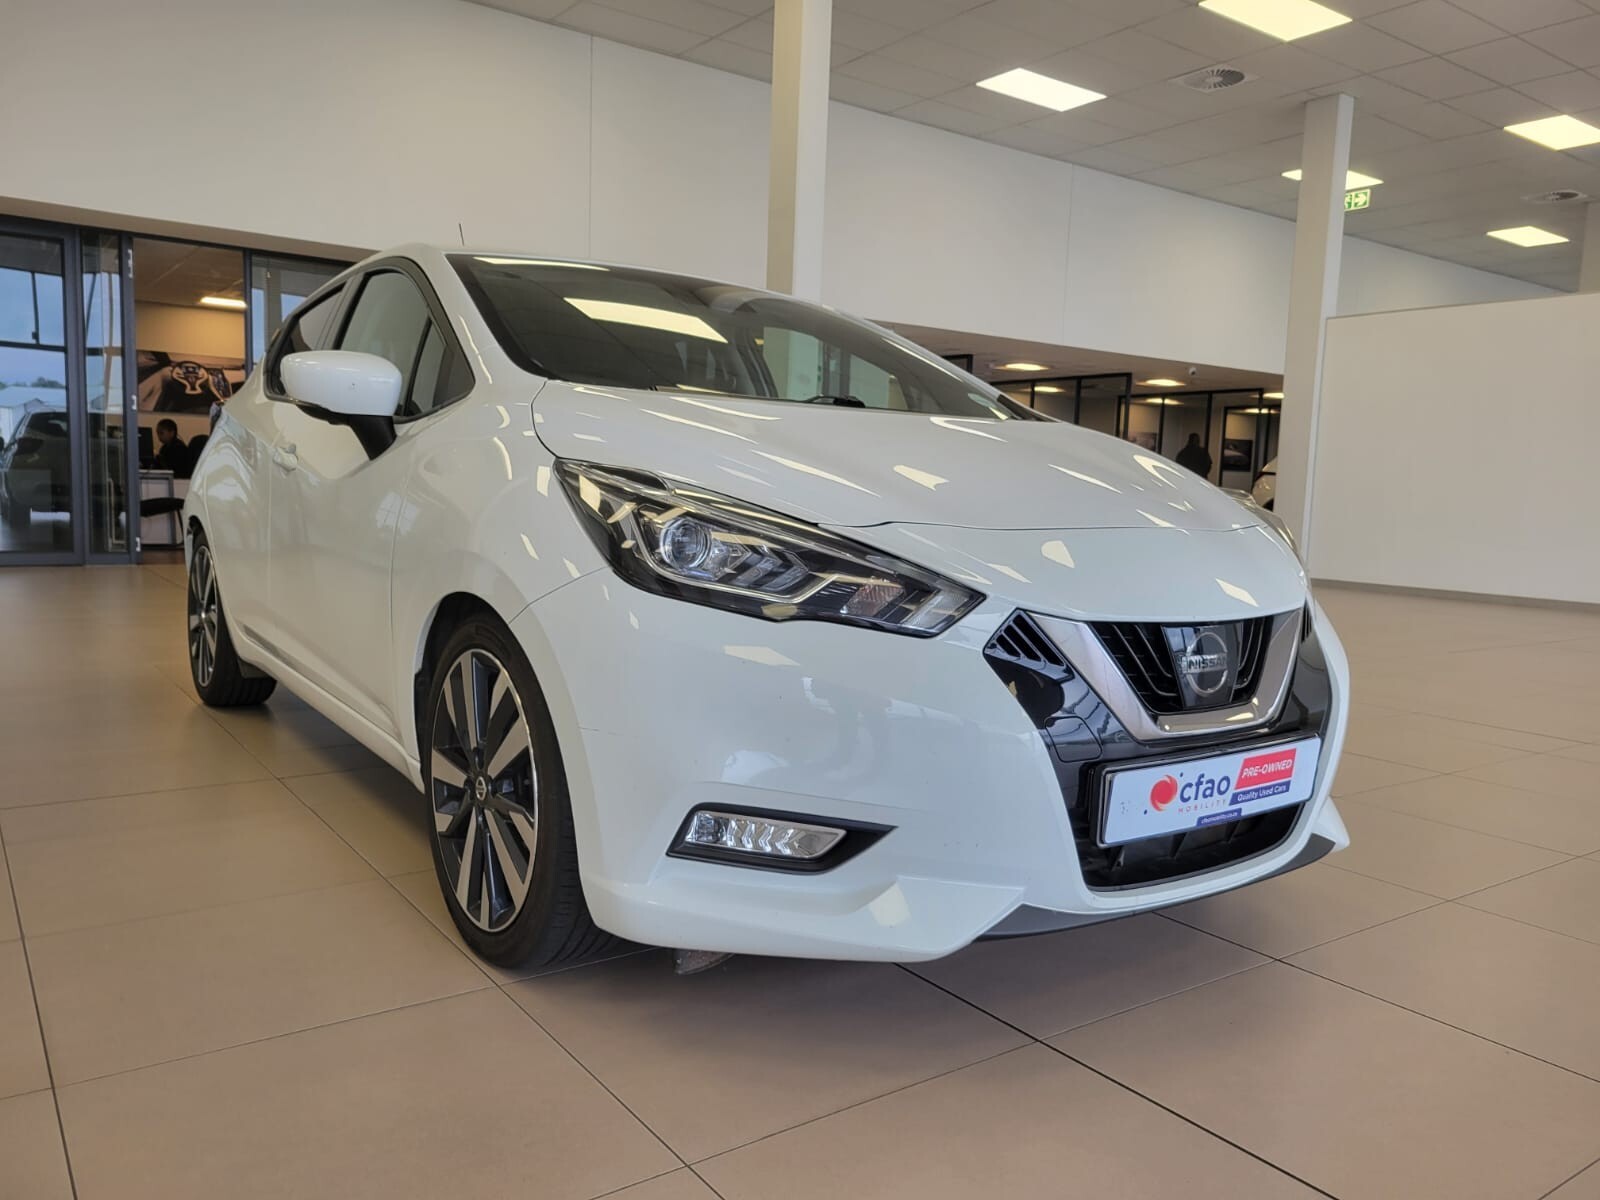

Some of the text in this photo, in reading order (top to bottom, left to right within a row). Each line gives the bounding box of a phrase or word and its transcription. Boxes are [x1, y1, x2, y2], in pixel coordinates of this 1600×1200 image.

[1241, 759, 1293, 779] PRE-OWNED
[1180, 773, 1231, 803] cfao
[1237, 785, 1287, 802] Quality Used Cars
[1178, 799, 1227, 813] MOBILITY
